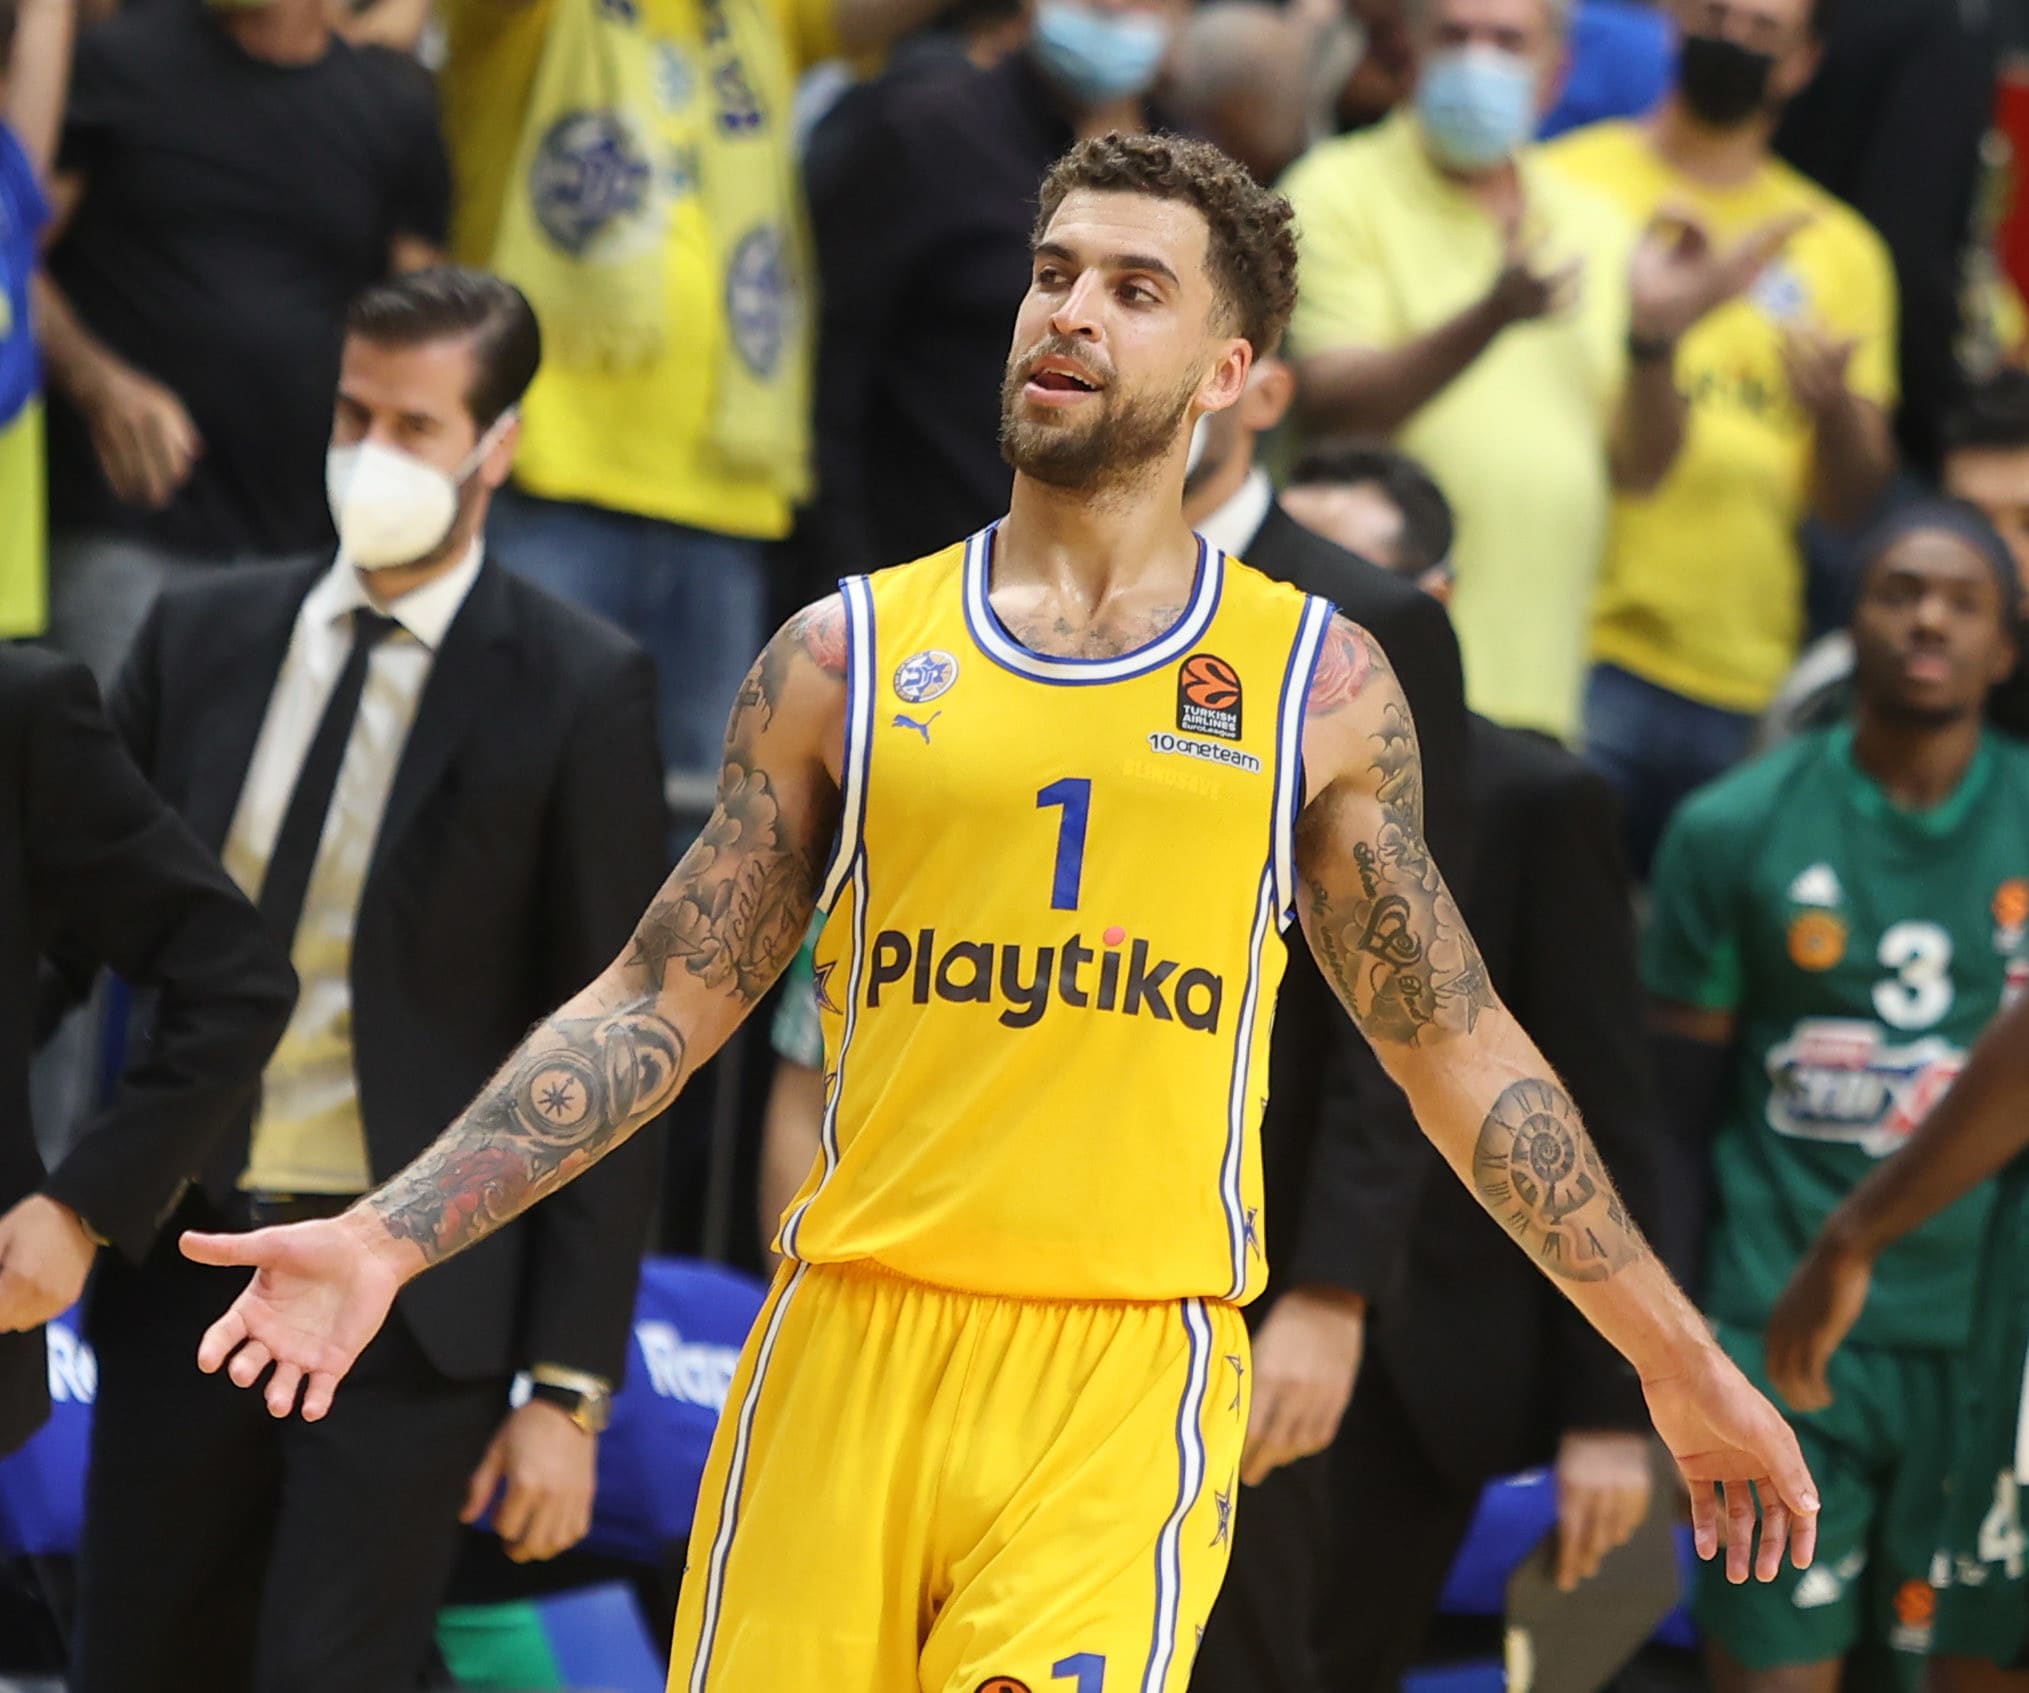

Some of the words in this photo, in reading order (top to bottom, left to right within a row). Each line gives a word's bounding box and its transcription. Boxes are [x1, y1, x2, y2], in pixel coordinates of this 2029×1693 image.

[1182, 713, 1237, 731] AIRLINES
[1183, 704, 1237, 723] TURKISH
[1036, 777, 1092, 911] 1
[866, 925, 1223, 1034] Playtika
[1870, 919, 1956, 1029] 3
